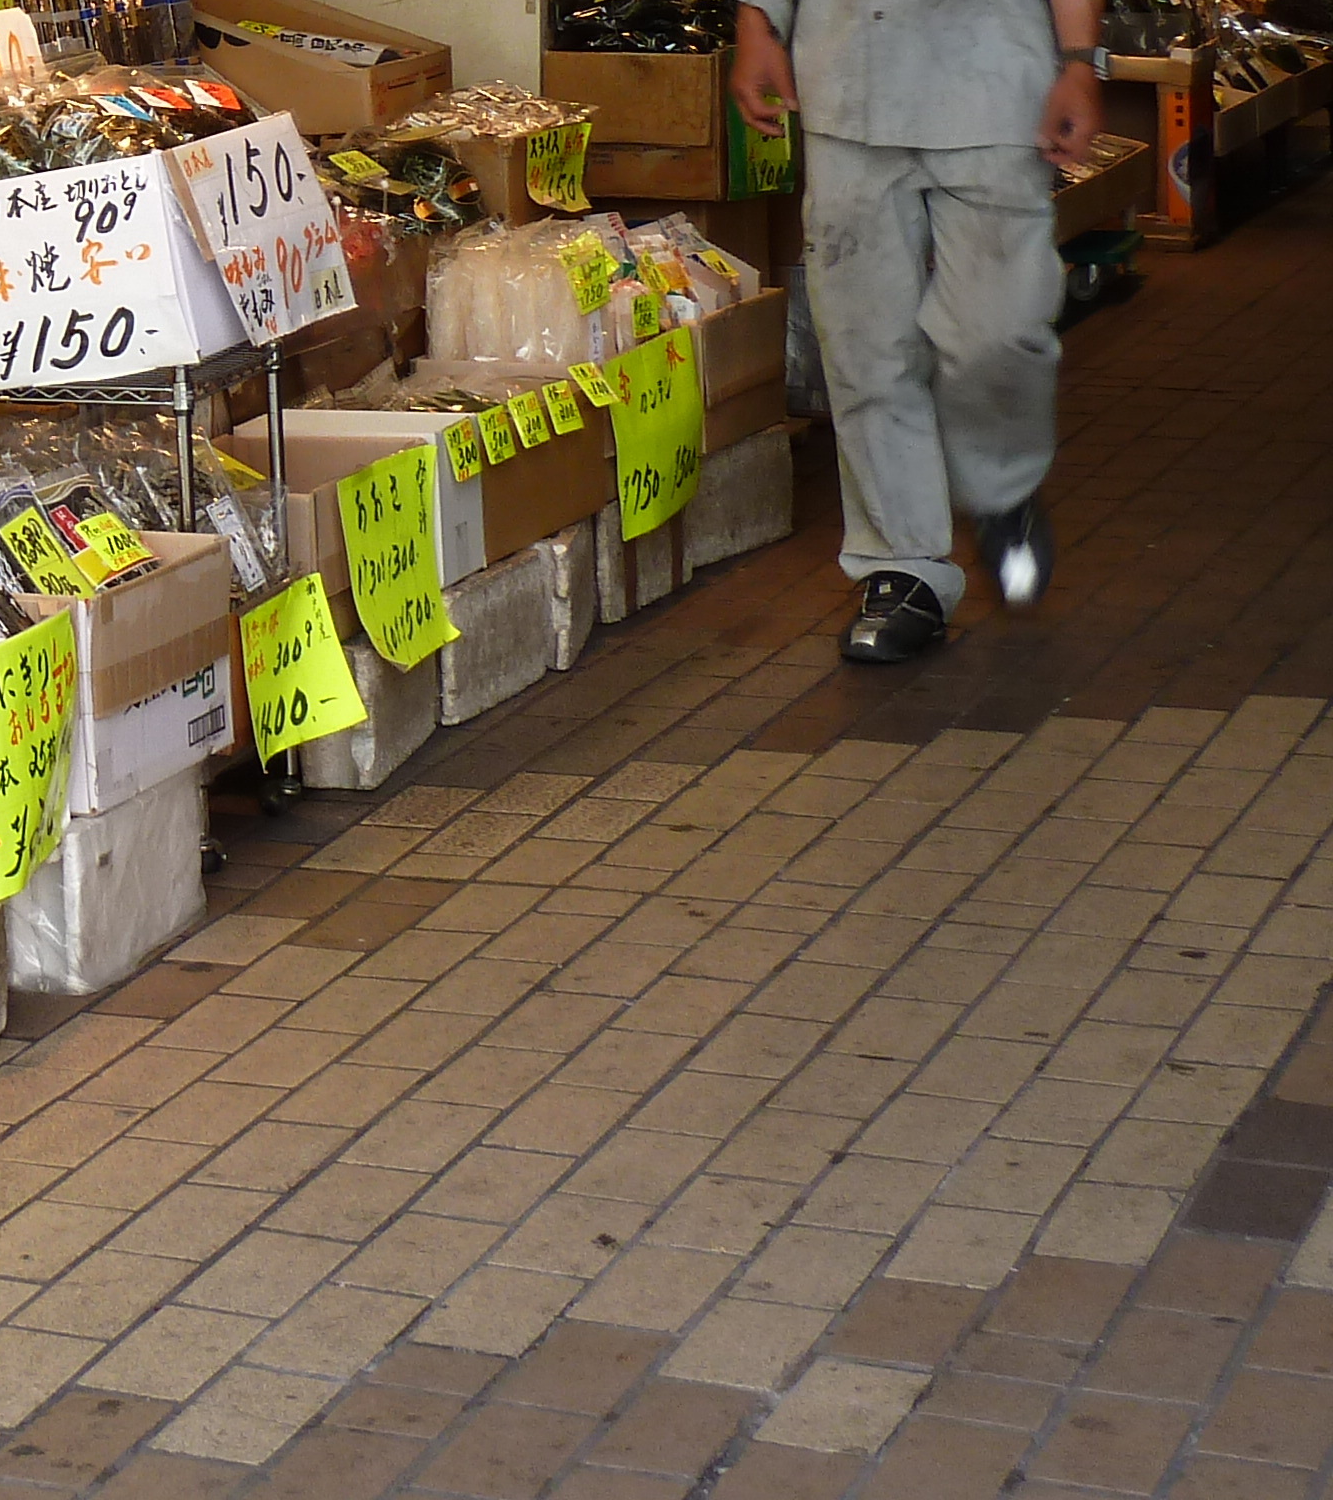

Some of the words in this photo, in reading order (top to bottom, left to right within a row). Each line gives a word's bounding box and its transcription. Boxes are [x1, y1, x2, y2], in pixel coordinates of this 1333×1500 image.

[65, 167, 147, 203] 切りおとし
[303, 221, 337, 269] グラム
